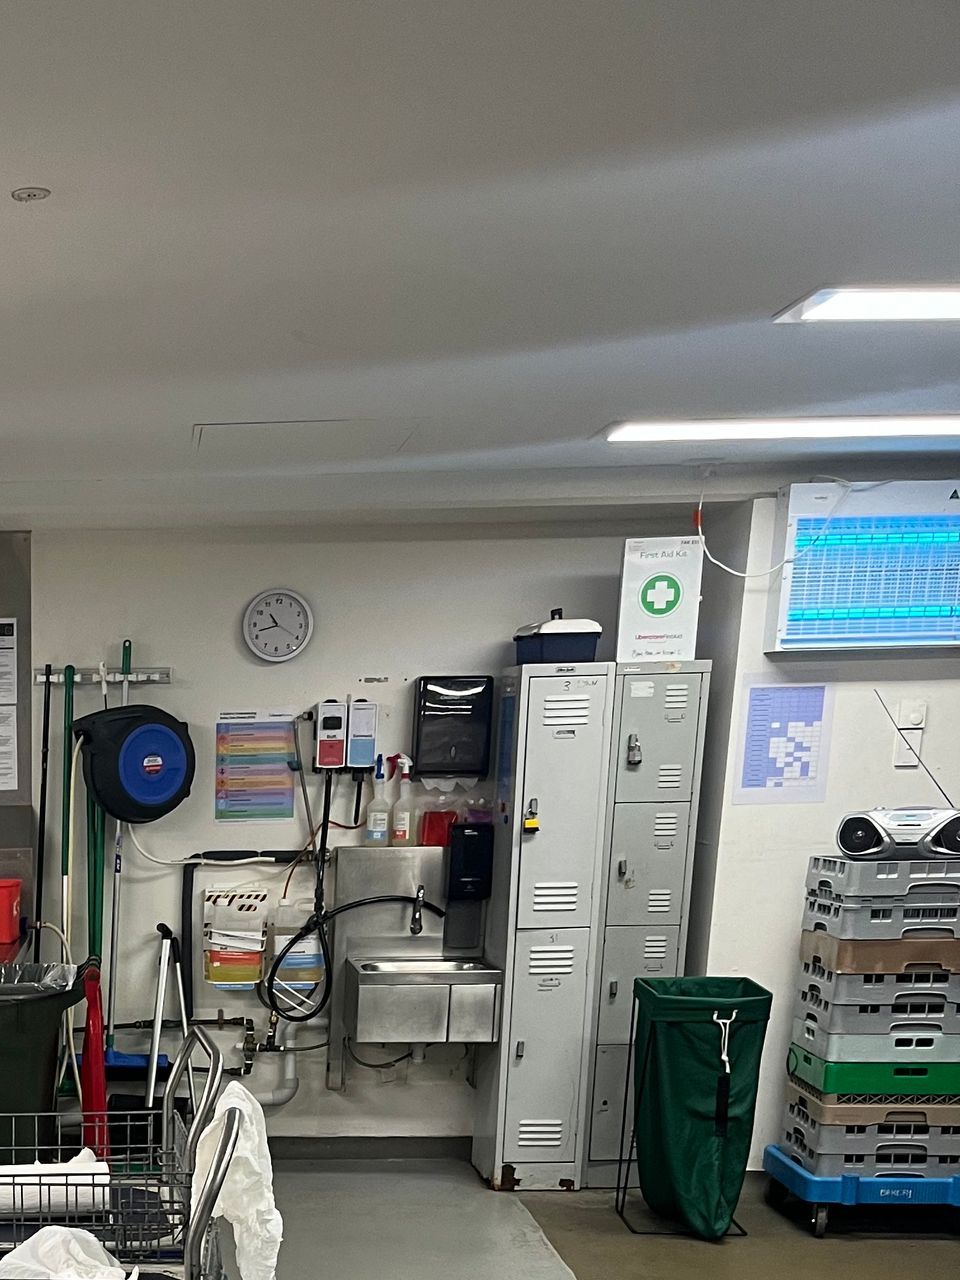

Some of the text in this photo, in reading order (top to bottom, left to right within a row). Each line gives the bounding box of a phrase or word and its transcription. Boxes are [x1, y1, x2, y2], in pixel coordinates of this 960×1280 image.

[640, 550, 688, 559] First Aid Kit
